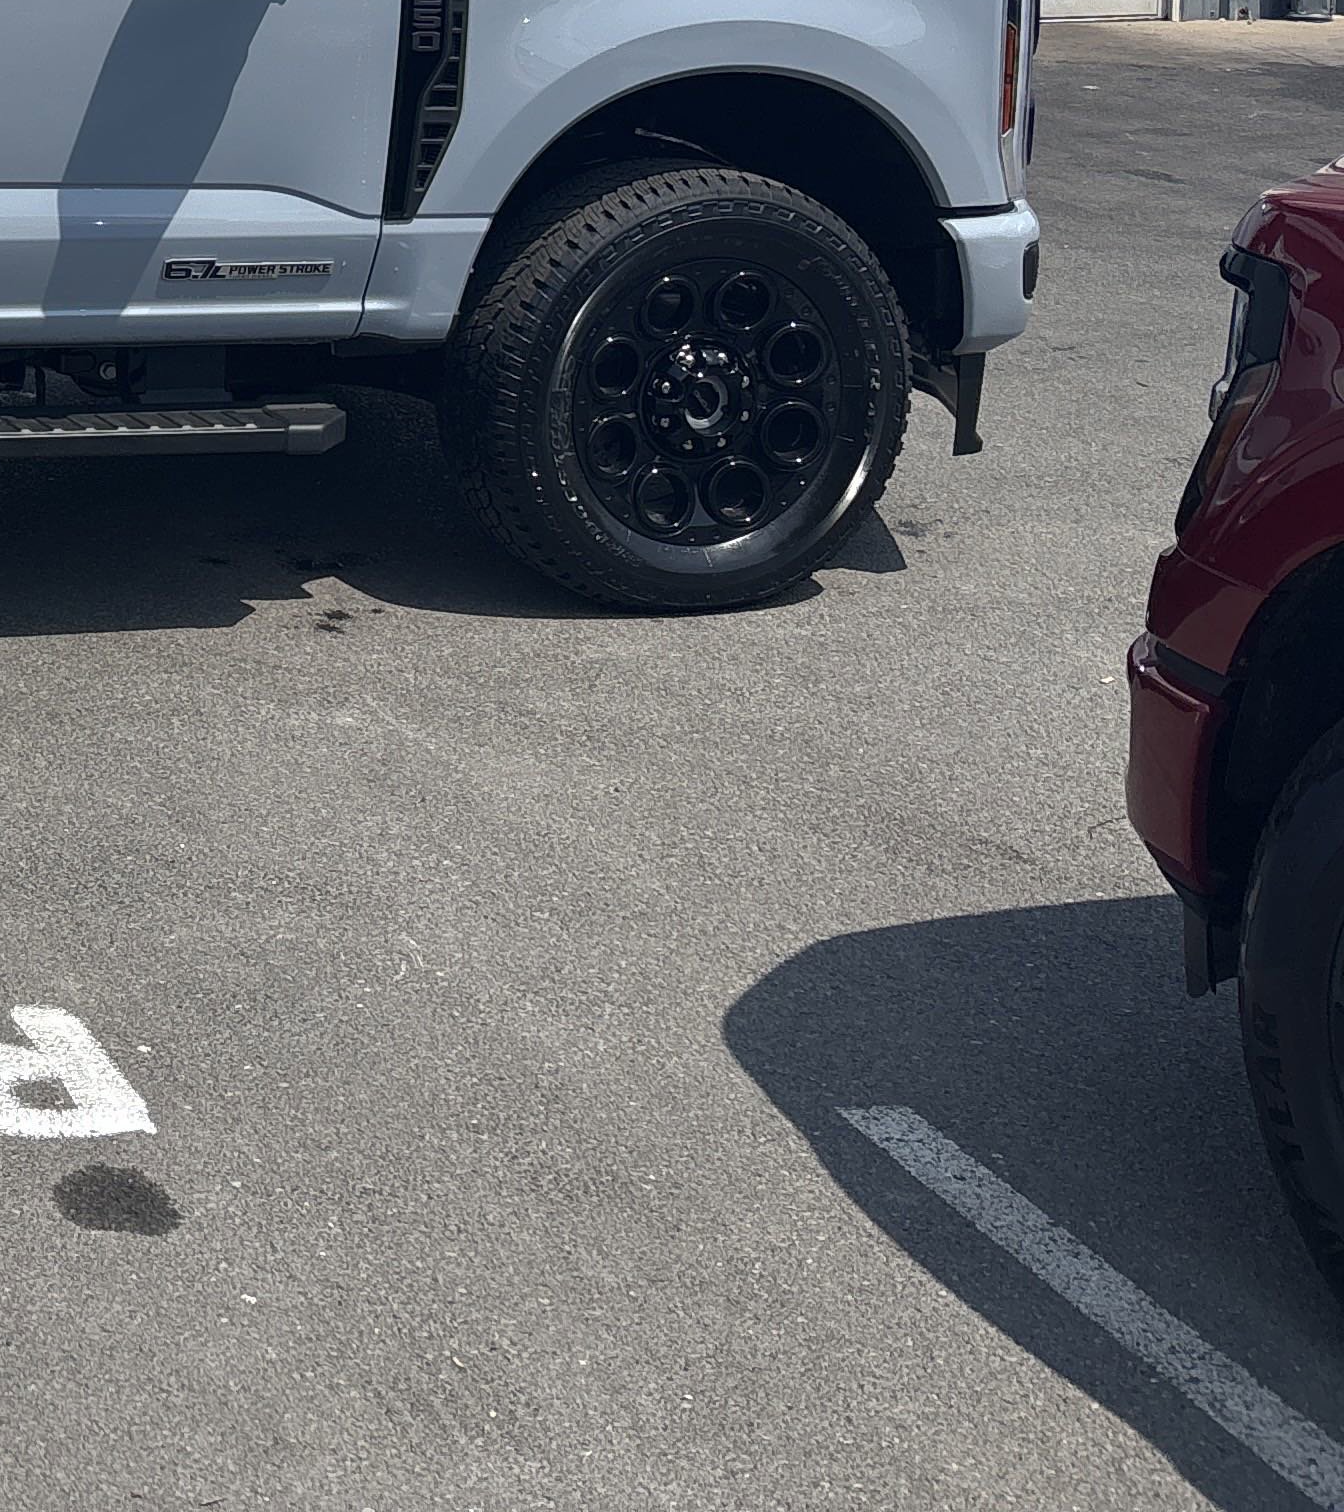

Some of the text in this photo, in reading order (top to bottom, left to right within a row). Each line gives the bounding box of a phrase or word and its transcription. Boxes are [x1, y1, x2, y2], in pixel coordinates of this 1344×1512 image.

[164, 260, 226, 279] 6.7L
[229, 264, 277, 275] POWER
[278, 263, 331, 274] STROKE
